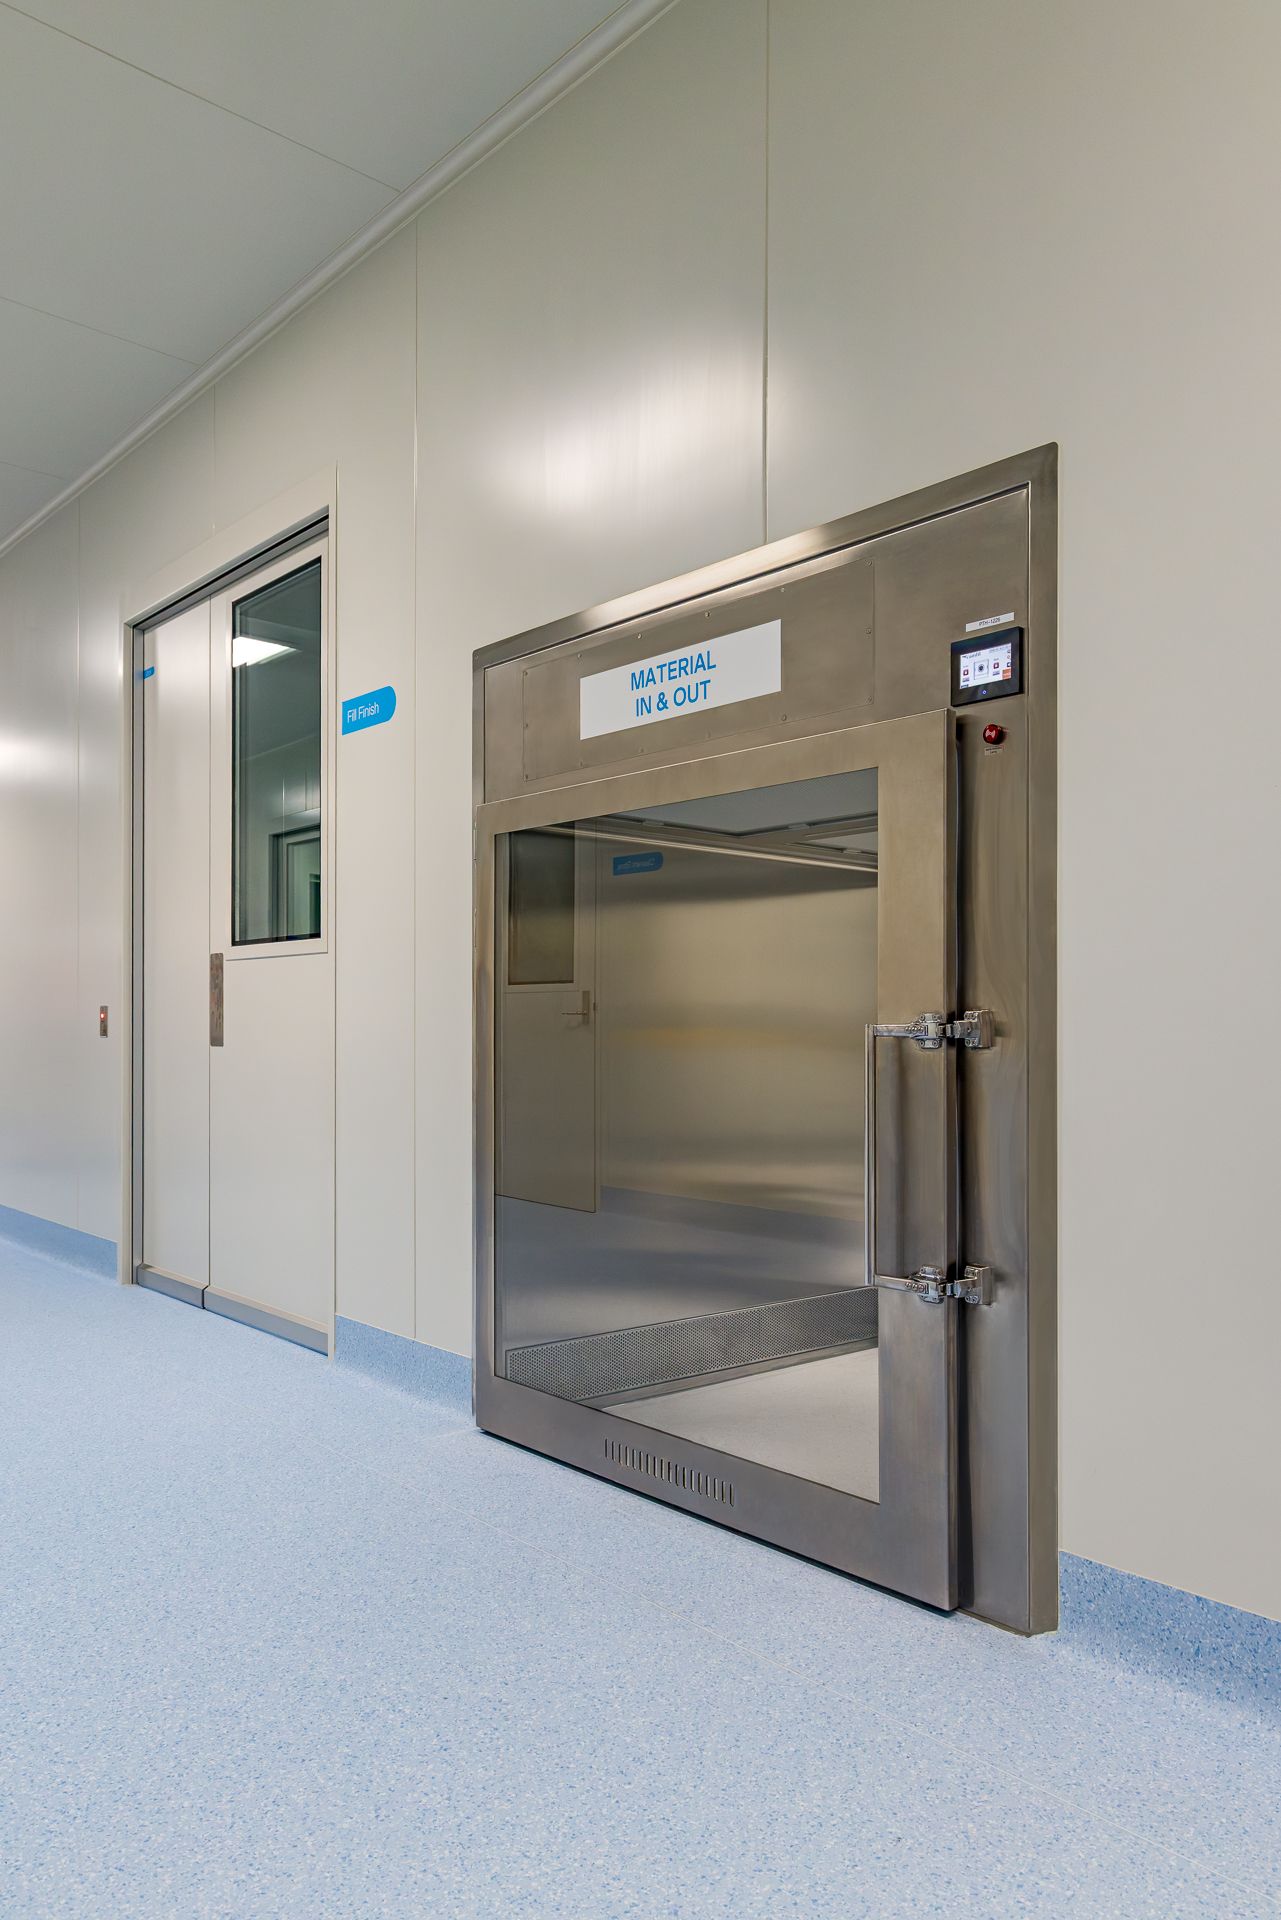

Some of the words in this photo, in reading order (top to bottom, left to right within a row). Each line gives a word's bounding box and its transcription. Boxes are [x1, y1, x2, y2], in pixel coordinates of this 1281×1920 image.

[631, 650, 717, 691] MATERIAL
[347, 708, 357, 723] Fill
[358, 701, 380, 720] Finish
[636, 695, 652, 717] IN
[656, 691, 669, 712] &
[673, 679, 711, 707] OUT
